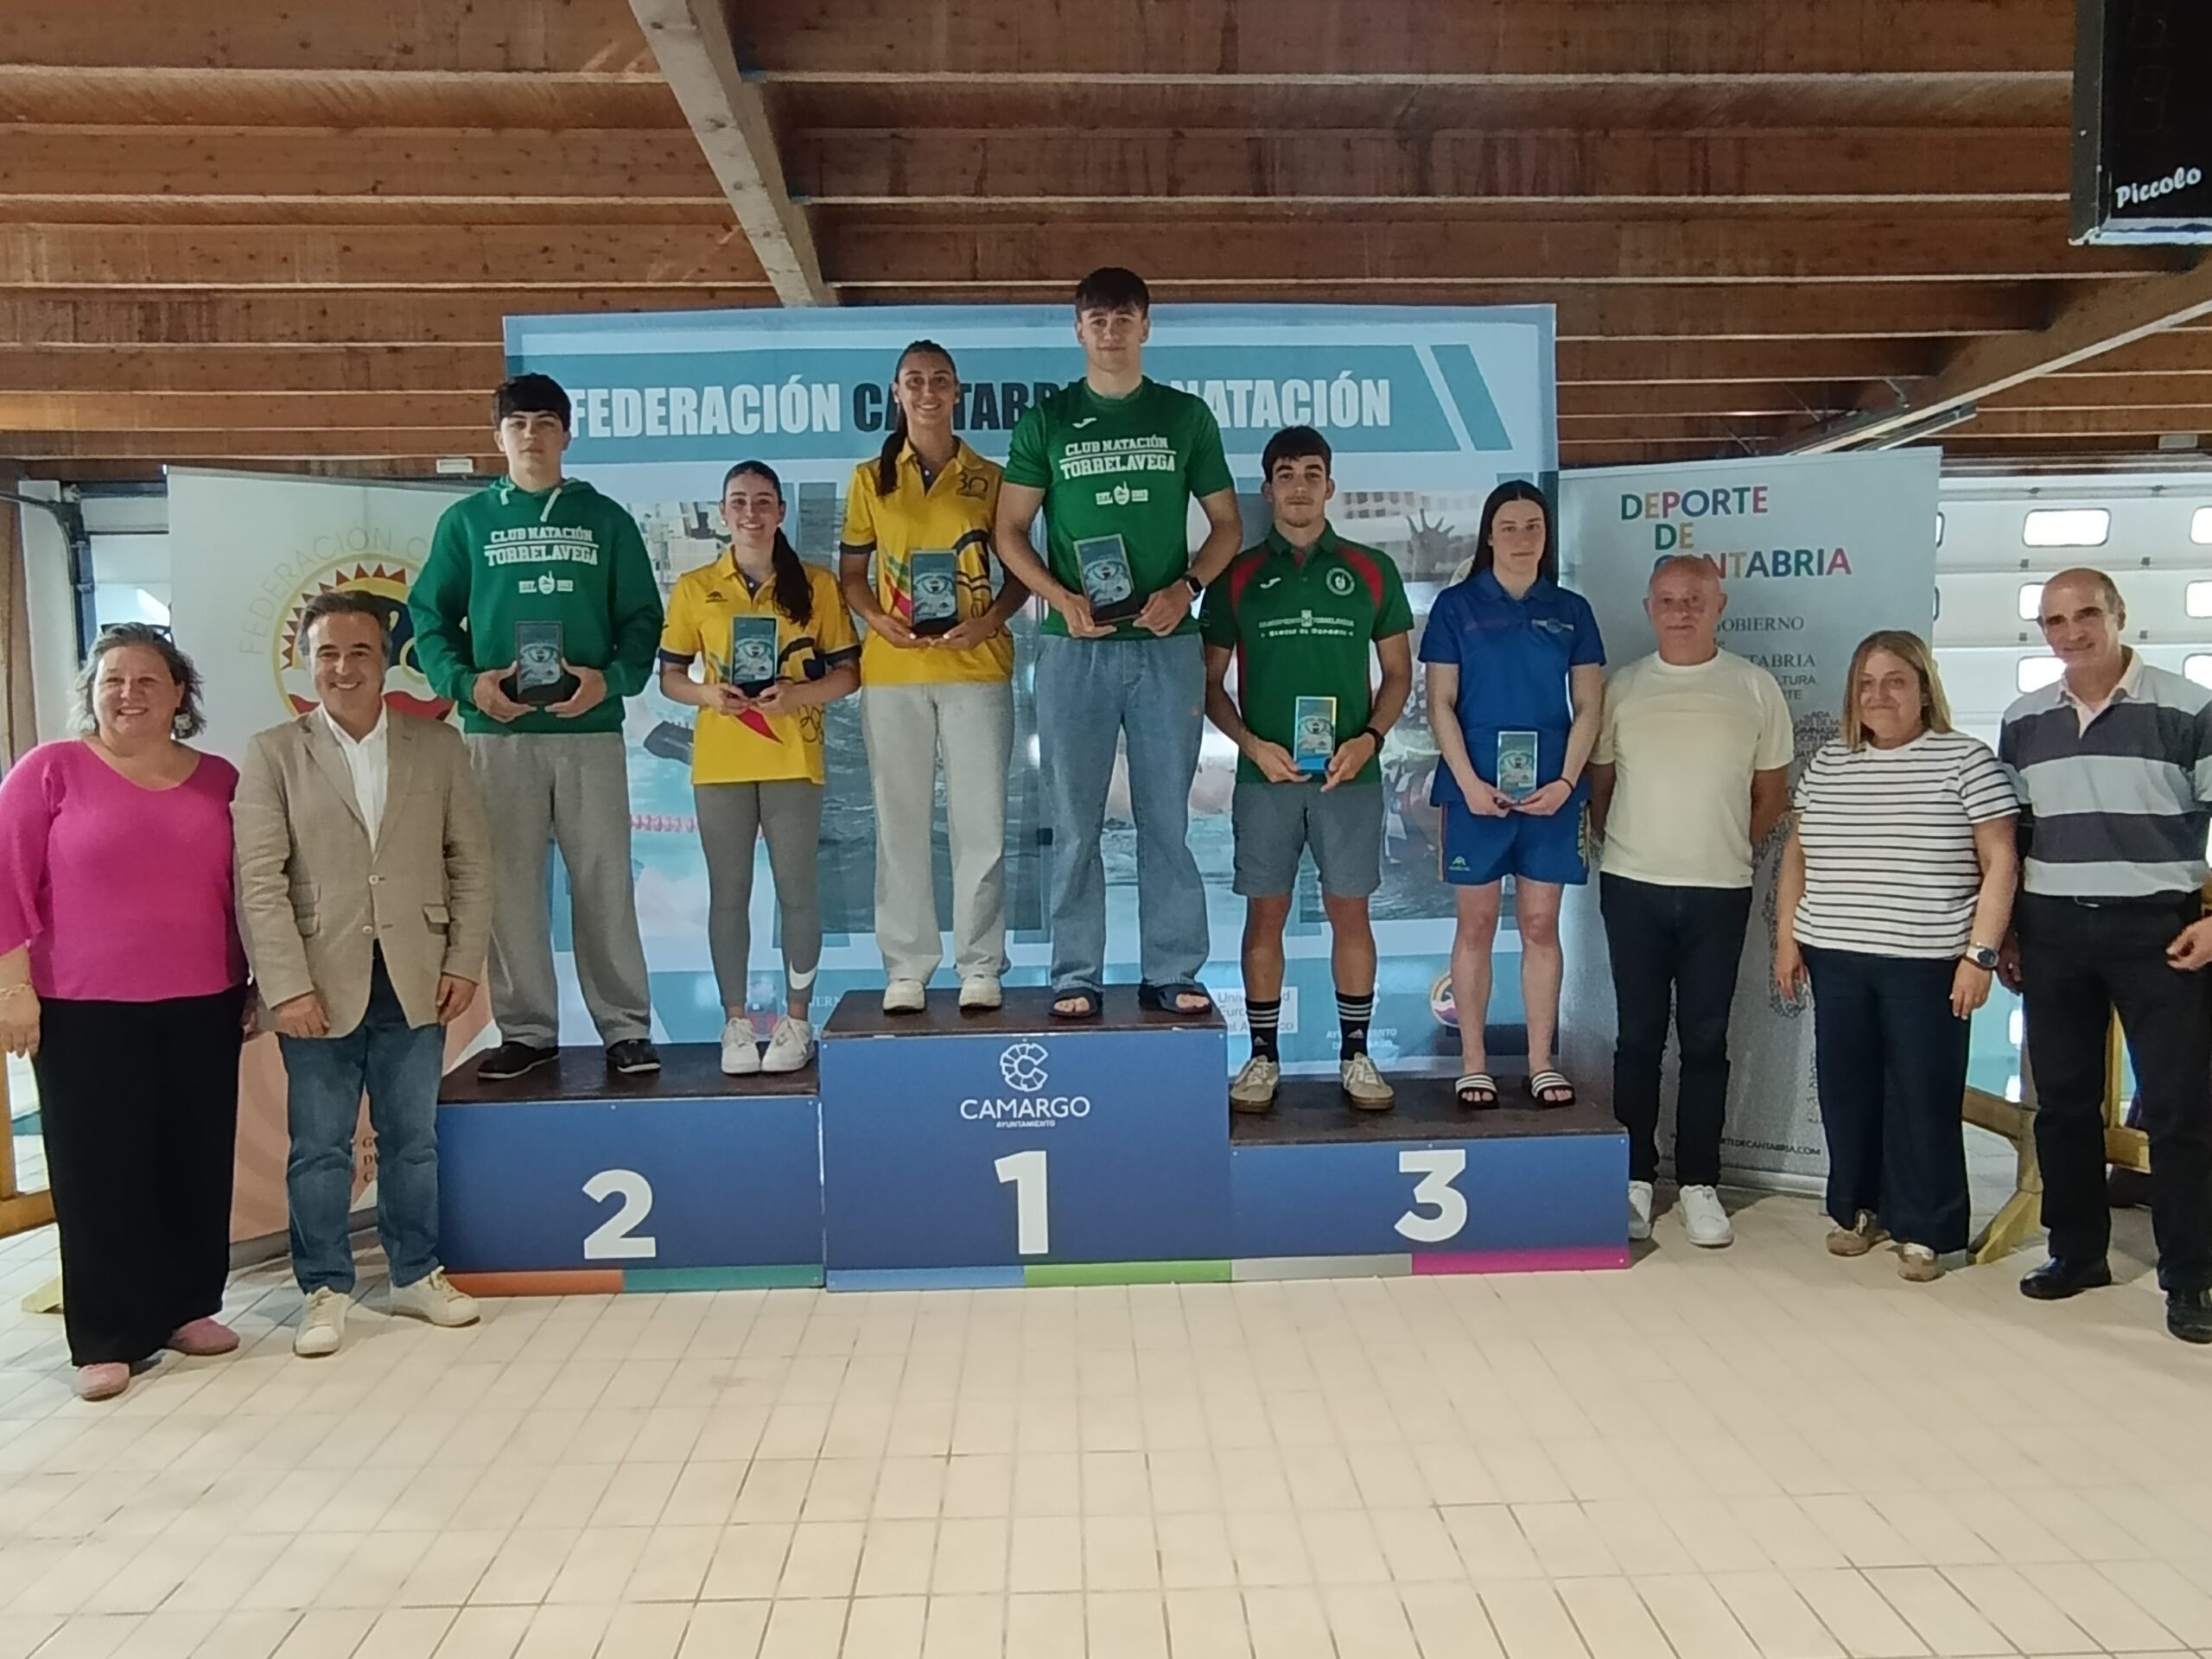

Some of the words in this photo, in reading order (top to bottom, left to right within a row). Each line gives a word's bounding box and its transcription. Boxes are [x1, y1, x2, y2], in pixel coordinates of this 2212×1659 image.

[2114, 166, 2202, 209] Piccolo
[565, 373, 842, 438] FEDERACIÓN
[1065, 441, 1101, 456] CLUB
[1102, 434, 1169, 452] NATACIÓN
[1059, 454, 1176, 480] TORRELAVEGA
[1620, 486, 1769, 521] DEPORTE
[490, 527, 526, 543] CLUB
[527, 525, 593, 542] NATACIÓN
[1654, 522, 1694, 550] DE
[483, 544, 598, 567] TORRELAVEGA
[1654, 547, 1853, 580] NTABRIA
[960, 1096, 1091, 1121] CAMARGO
[995, 1119, 1057, 1128] AYUNTAMIENTO
[994, 1150, 1049, 1255] 1
[1394, 1148, 1468, 1243] 3
[582, 1168, 657, 1260] 2
